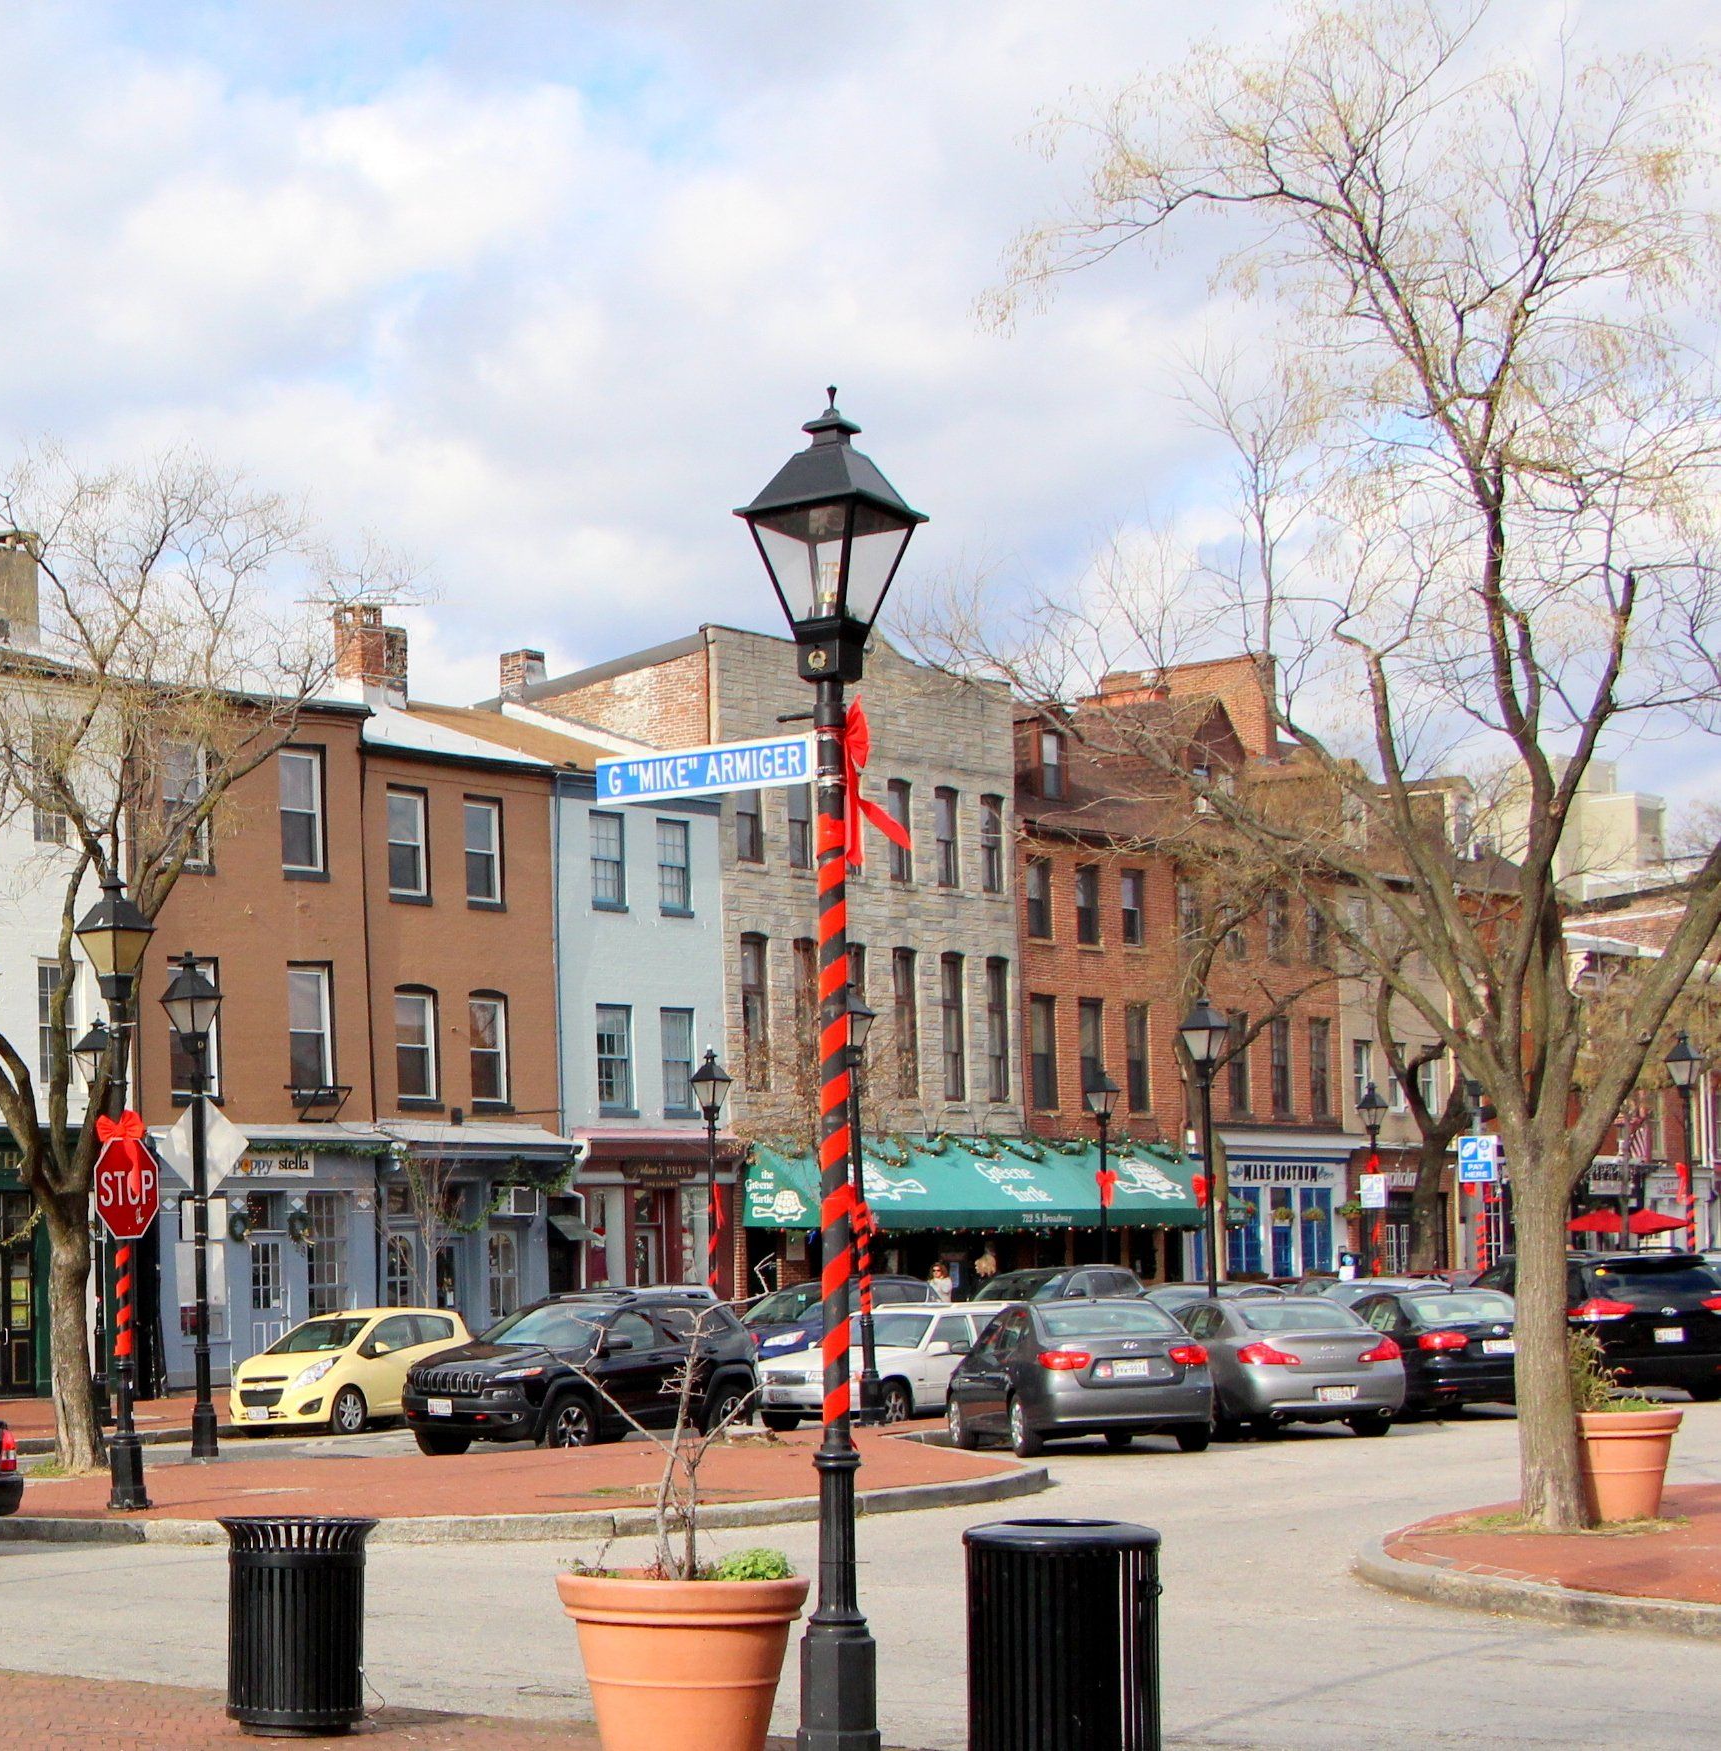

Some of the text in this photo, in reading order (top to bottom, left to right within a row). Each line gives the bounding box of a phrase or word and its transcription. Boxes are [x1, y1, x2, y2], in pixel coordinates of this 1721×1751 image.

[608, 745, 801, 795] G "MIKE" ARMIGER
[233, 1155, 309, 1176] poppy stella
[974, 1162, 1035, 1184] Greene
[1243, 1164, 1319, 1182] MARE NOSTRUM
[1468, 1163, 1485, 1171] PAY
[761, 1169, 774, 1180] the
[745, 1179, 774, 1192] Greene
[1001, 1184, 1053, 1202] Turtle
[750, 1192, 774, 1204] Turtle
[1042, 1213, 1072, 1224] Broadway
